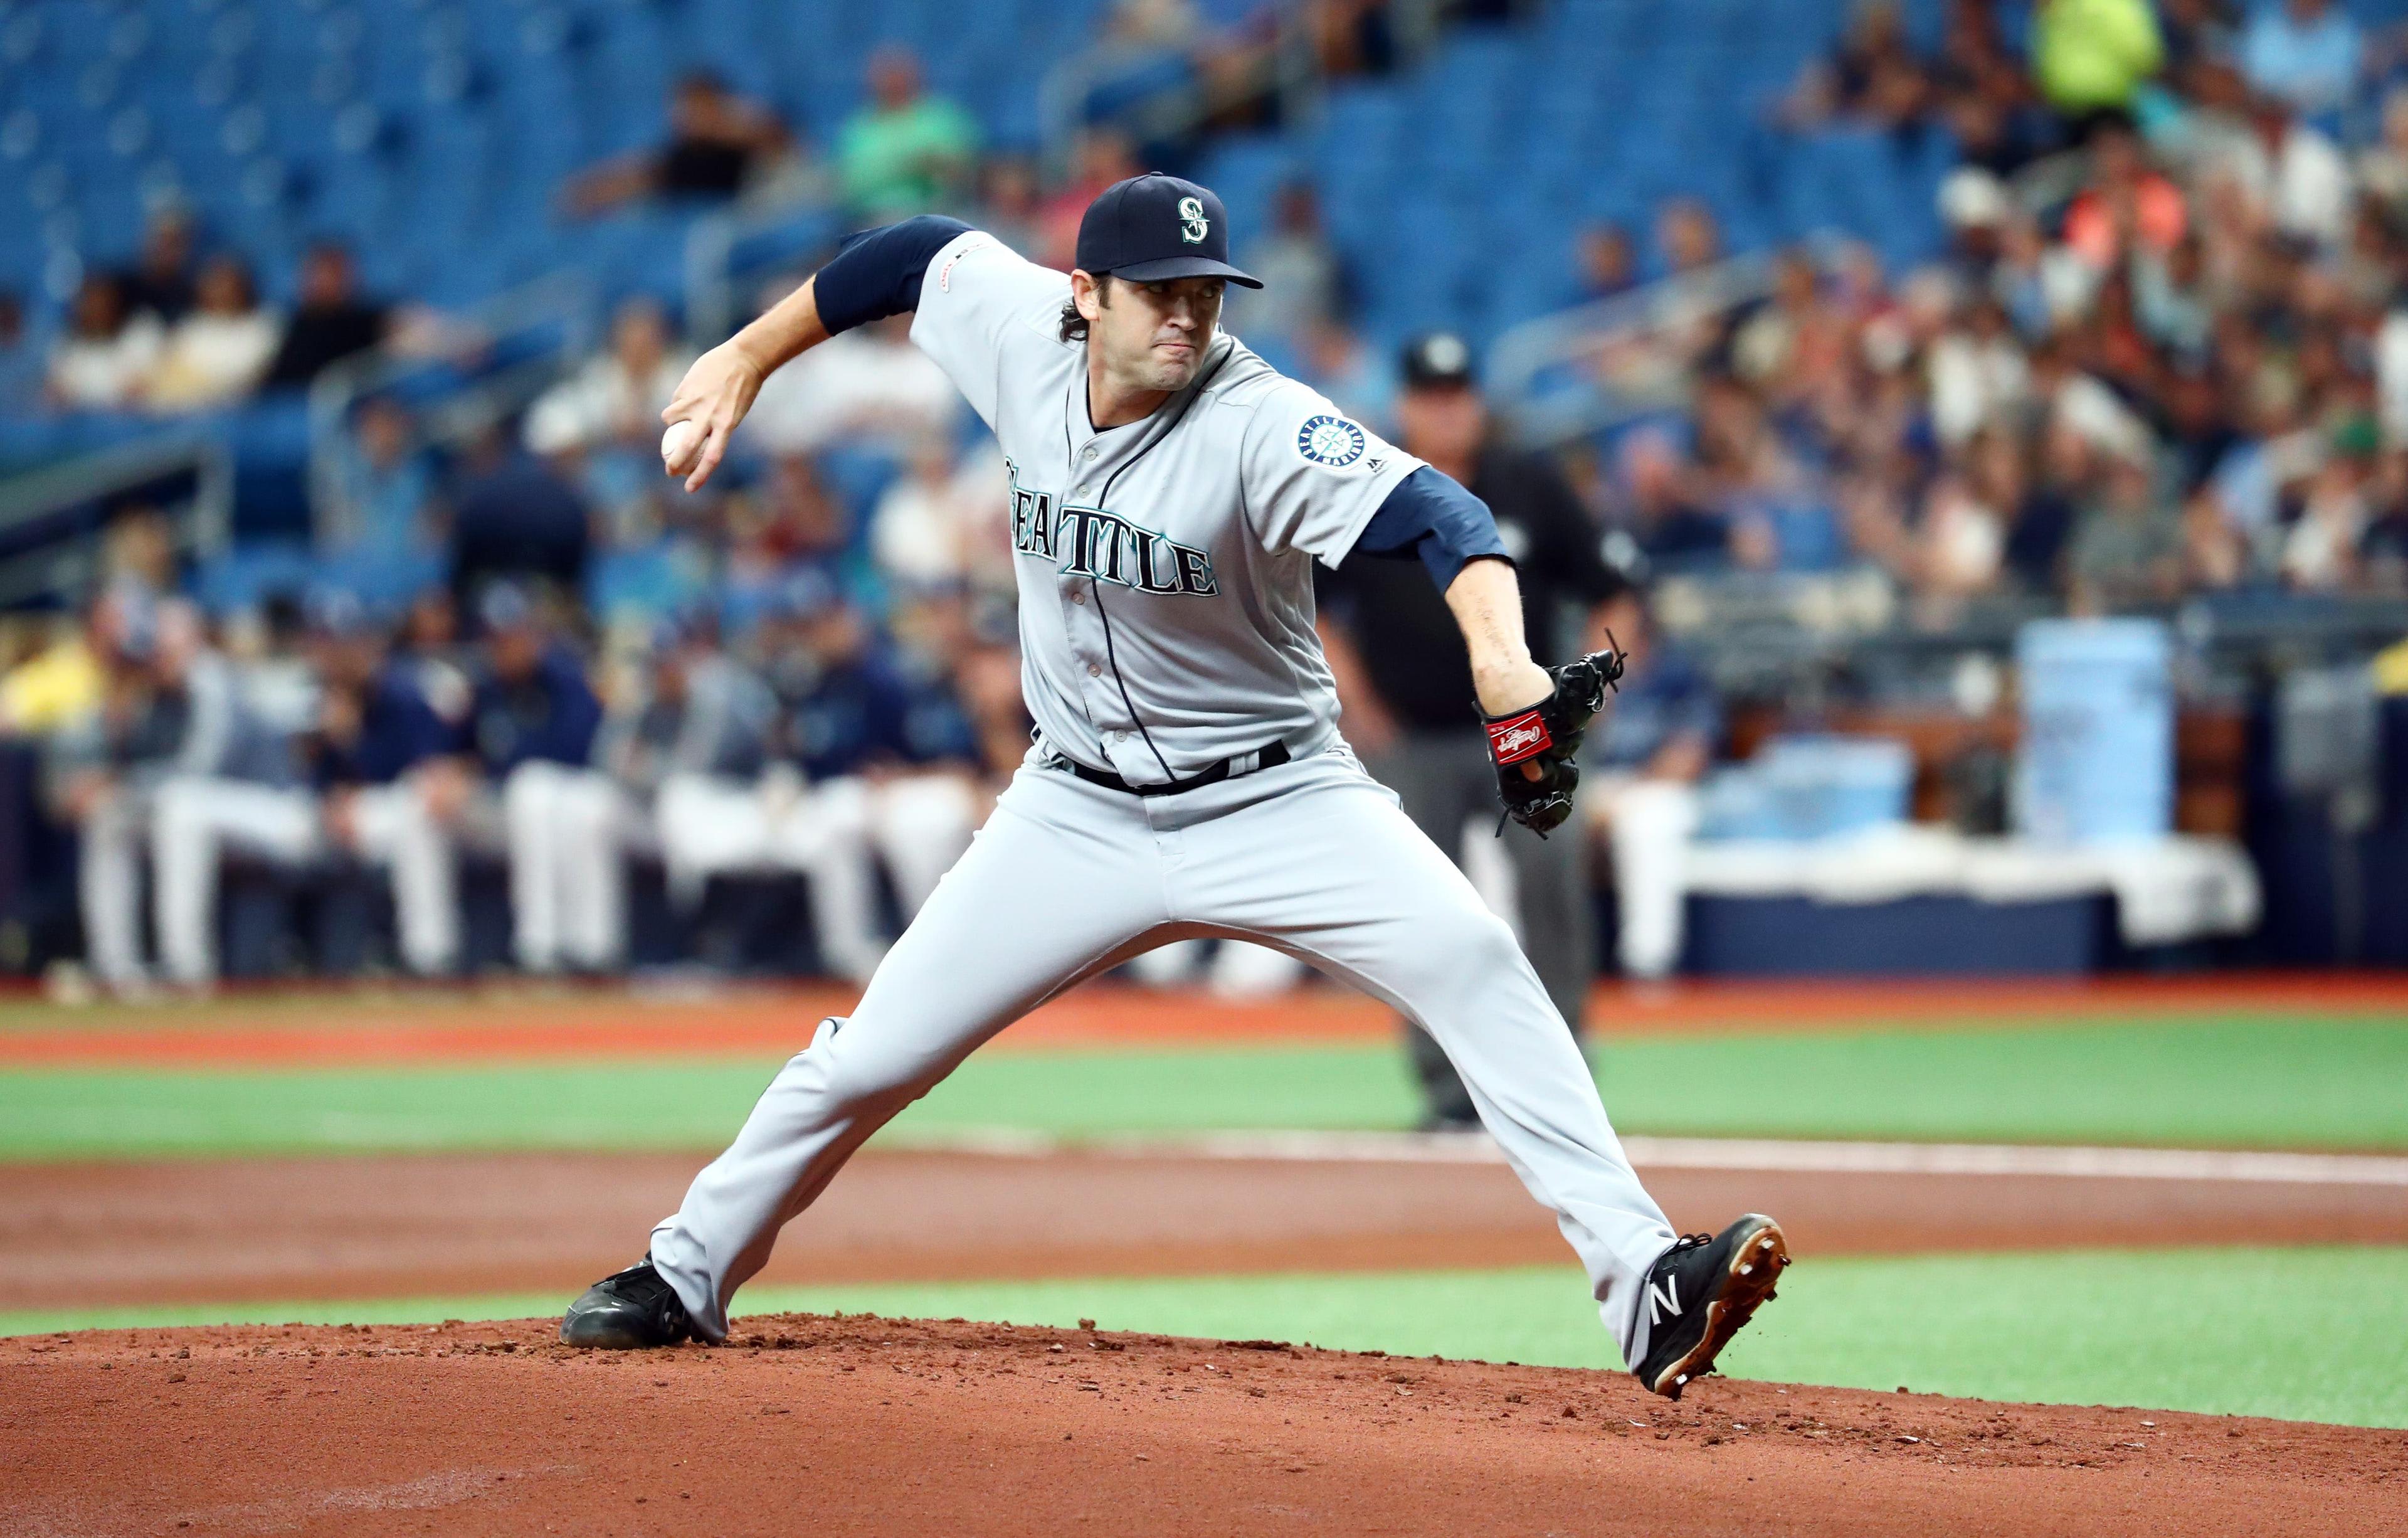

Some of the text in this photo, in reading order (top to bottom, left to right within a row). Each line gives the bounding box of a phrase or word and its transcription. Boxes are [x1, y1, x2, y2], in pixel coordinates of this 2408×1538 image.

[1178, 196, 1210, 244] S
[1299, 416, 1340, 456] SEATTLE
[1322, 428, 1364, 466] MARINERS
[1005, 456, 1220, 597] EATTLE
[1650, 1271, 1683, 1327] N
